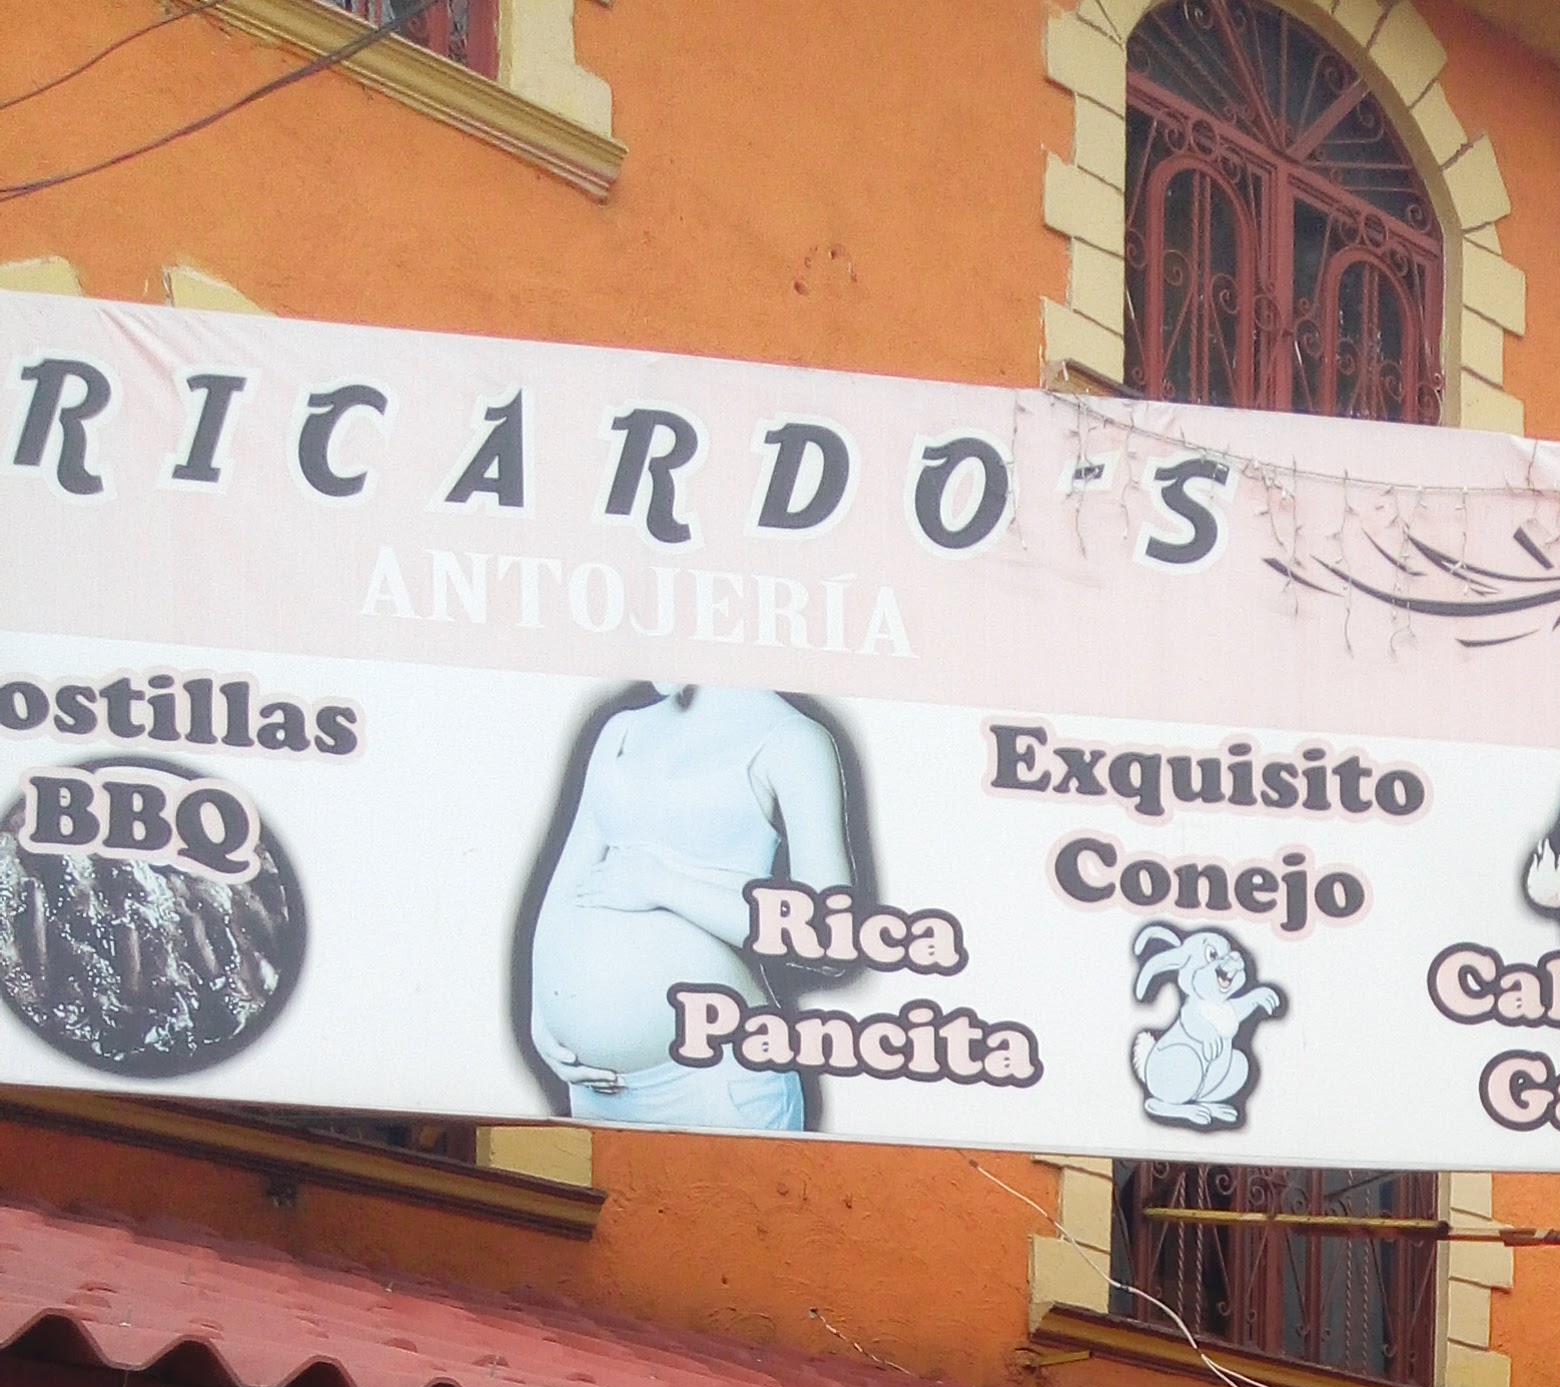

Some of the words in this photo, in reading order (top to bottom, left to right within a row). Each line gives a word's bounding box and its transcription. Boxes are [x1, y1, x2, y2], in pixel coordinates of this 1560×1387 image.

[14, 357, 1231, 566] RICARDO'S
[358, 545, 920, 660] ANTOJERÍA
[988, 723, 1426, 817] Exquisito
[29, 775, 250, 875] BBQ
[746, 880, 967, 973] Rica
[1054, 837, 1366, 933] Conejo
[669, 984, 1042, 1086] Pancita
